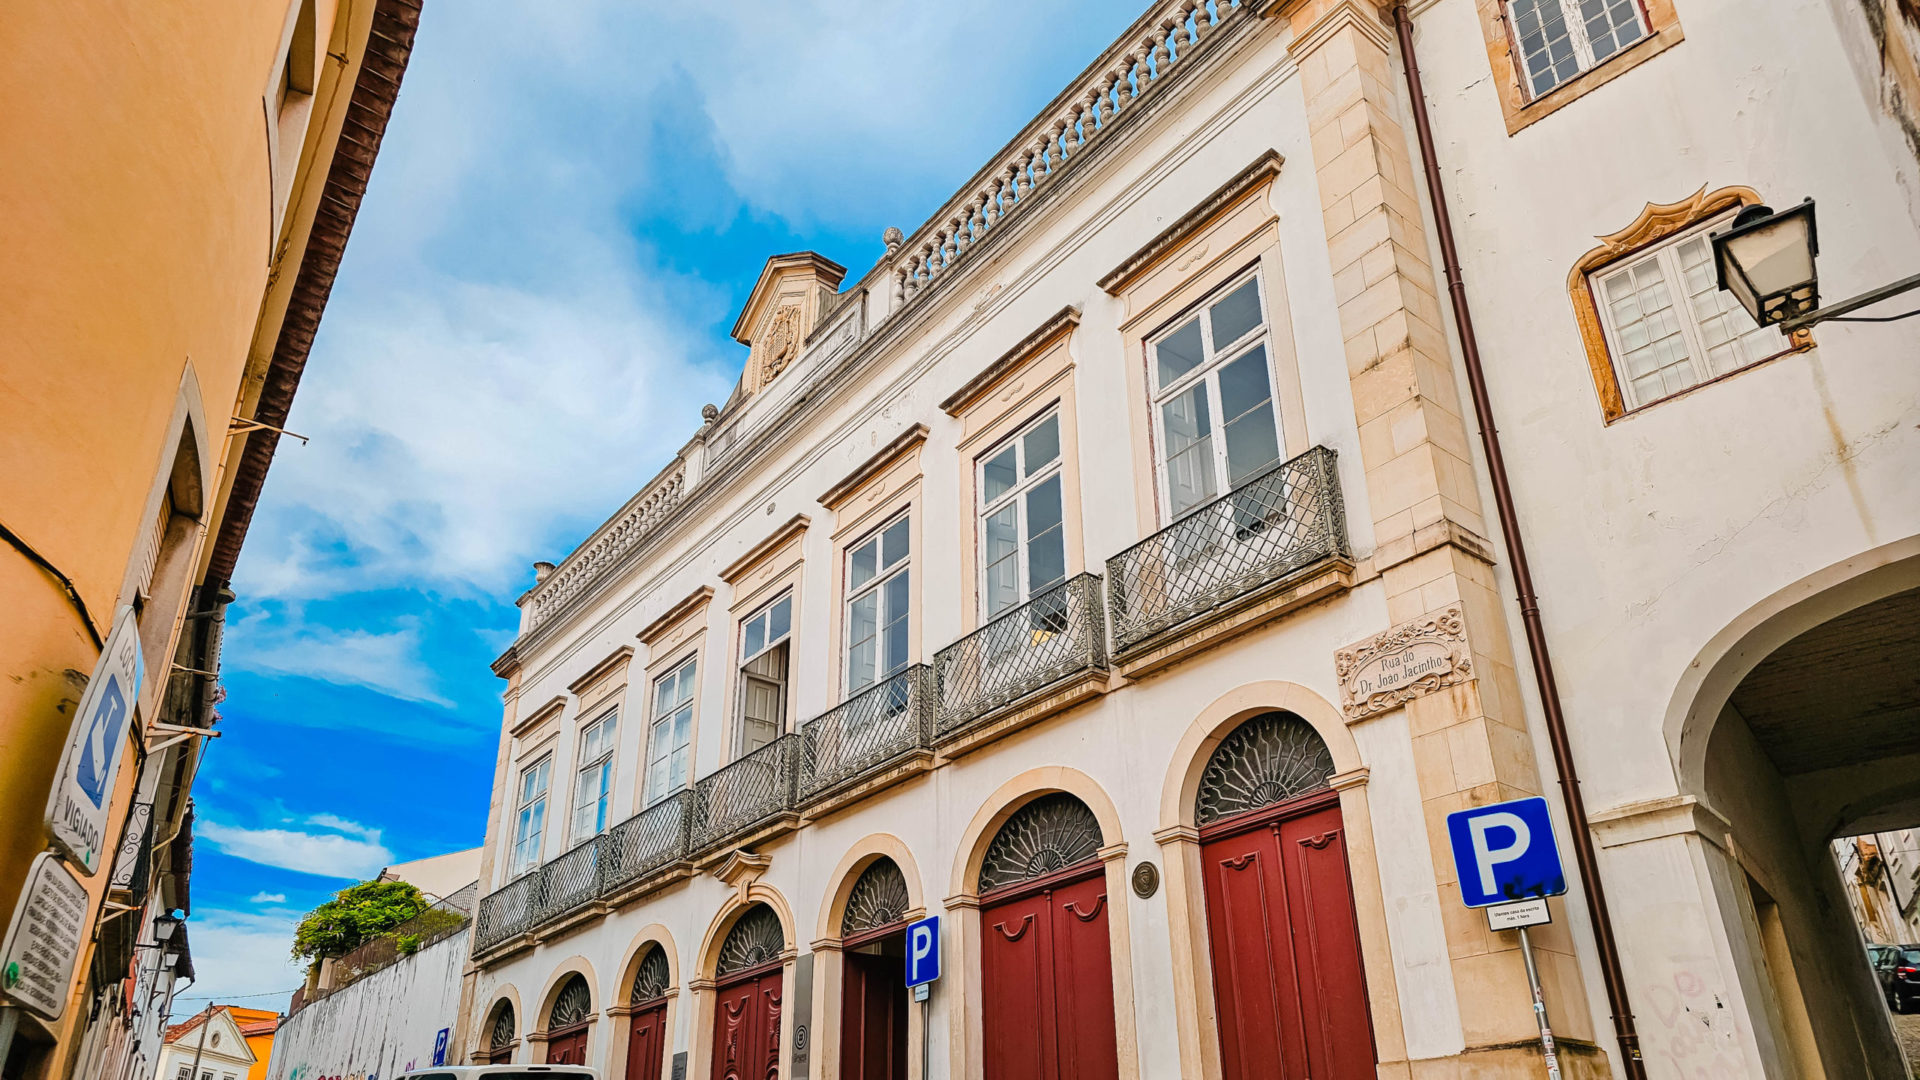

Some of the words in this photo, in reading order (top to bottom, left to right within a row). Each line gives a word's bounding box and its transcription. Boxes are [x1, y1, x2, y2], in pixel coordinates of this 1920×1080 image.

[1381, 658, 1400, 672] Rua
[1402, 651, 1415, 664] do
[1402, 656, 1442, 679] Jacintho
[64, 795, 99, 854] VIGIADO
[1467, 812, 1531, 897] P
[912, 925, 932, 981] P
